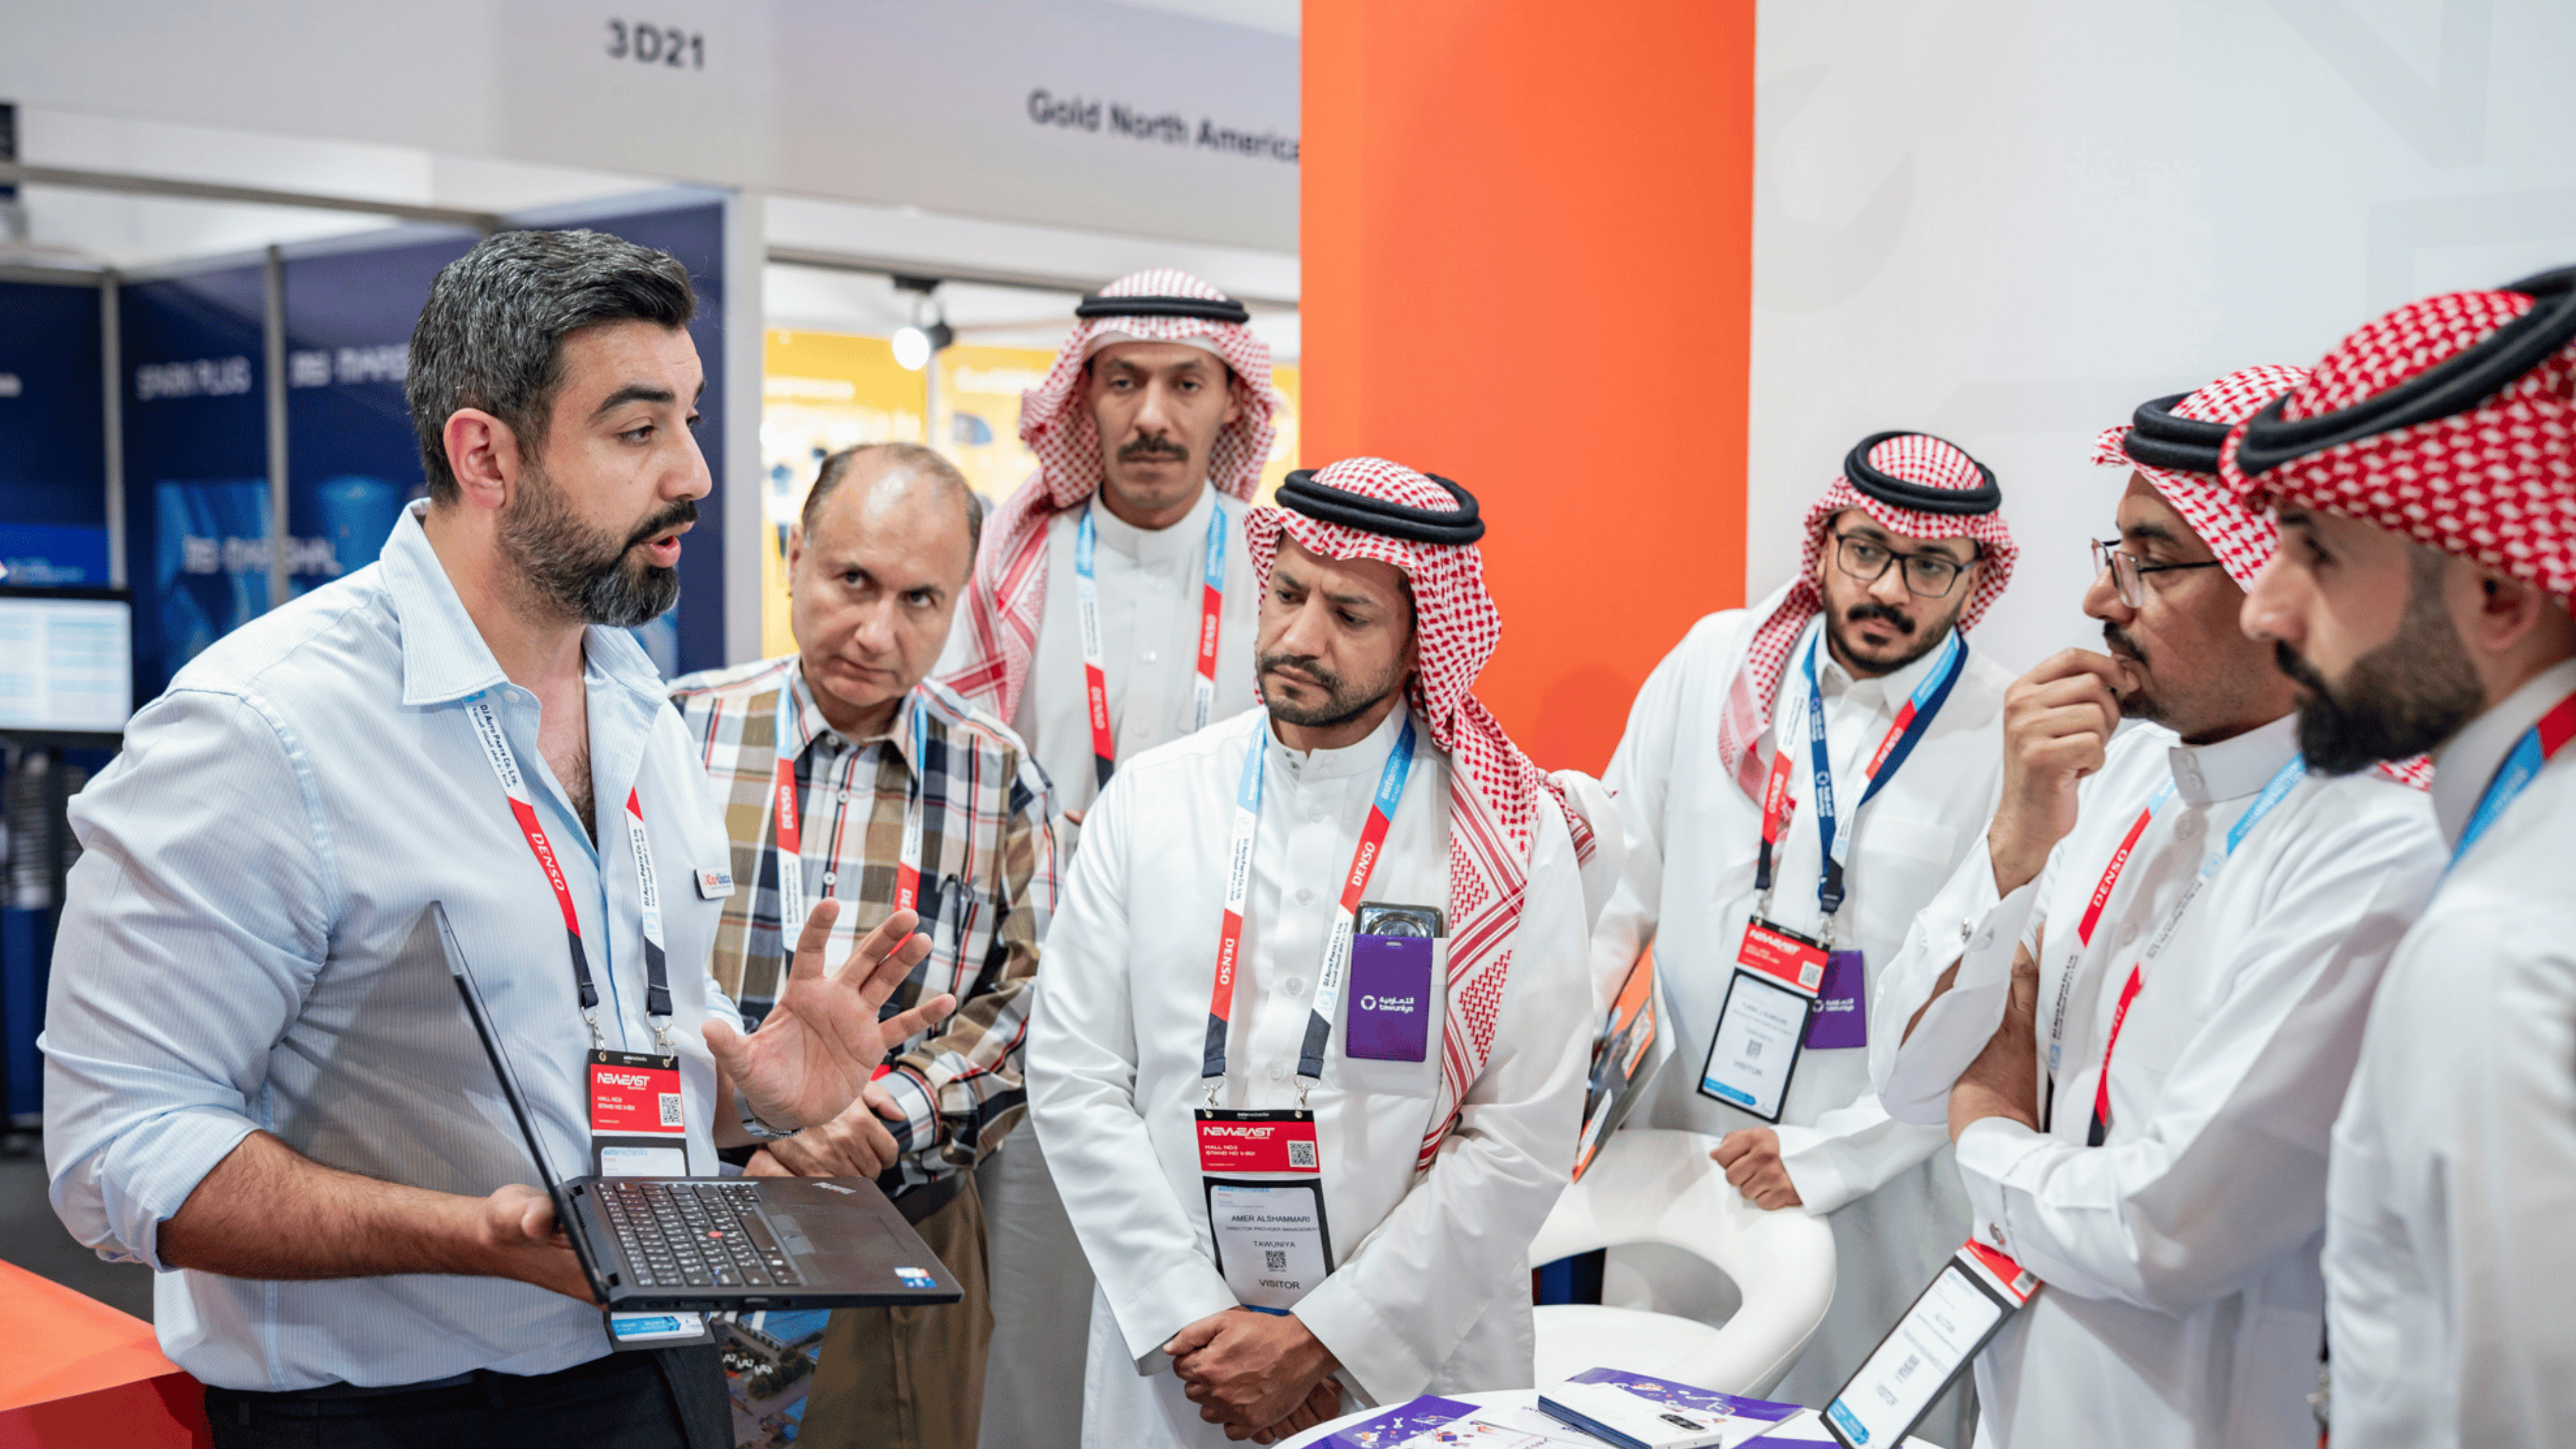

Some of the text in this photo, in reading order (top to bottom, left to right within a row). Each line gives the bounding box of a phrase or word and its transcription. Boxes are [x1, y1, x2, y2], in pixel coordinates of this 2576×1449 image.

[605, 19, 704, 71] 3D21
[1027, 88, 1100, 132] Gold
[1108, 104, 1189, 144] North
[781, 785, 793, 829] DENSO
[531, 833, 564, 891] DENSO
[1352, 842, 1375, 887] DENSO
[2092, 848, 2128, 908] DENSO
[1219, 938, 1235, 985] DENSO
[1379, 1004, 1414, 1014] tawuniya
[597, 1072, 650, 1086] NEWEAST
[1203, 1126, 1275, 1137] NEWEAST
[1258, 1279, 1300, 1289] VISITOR
